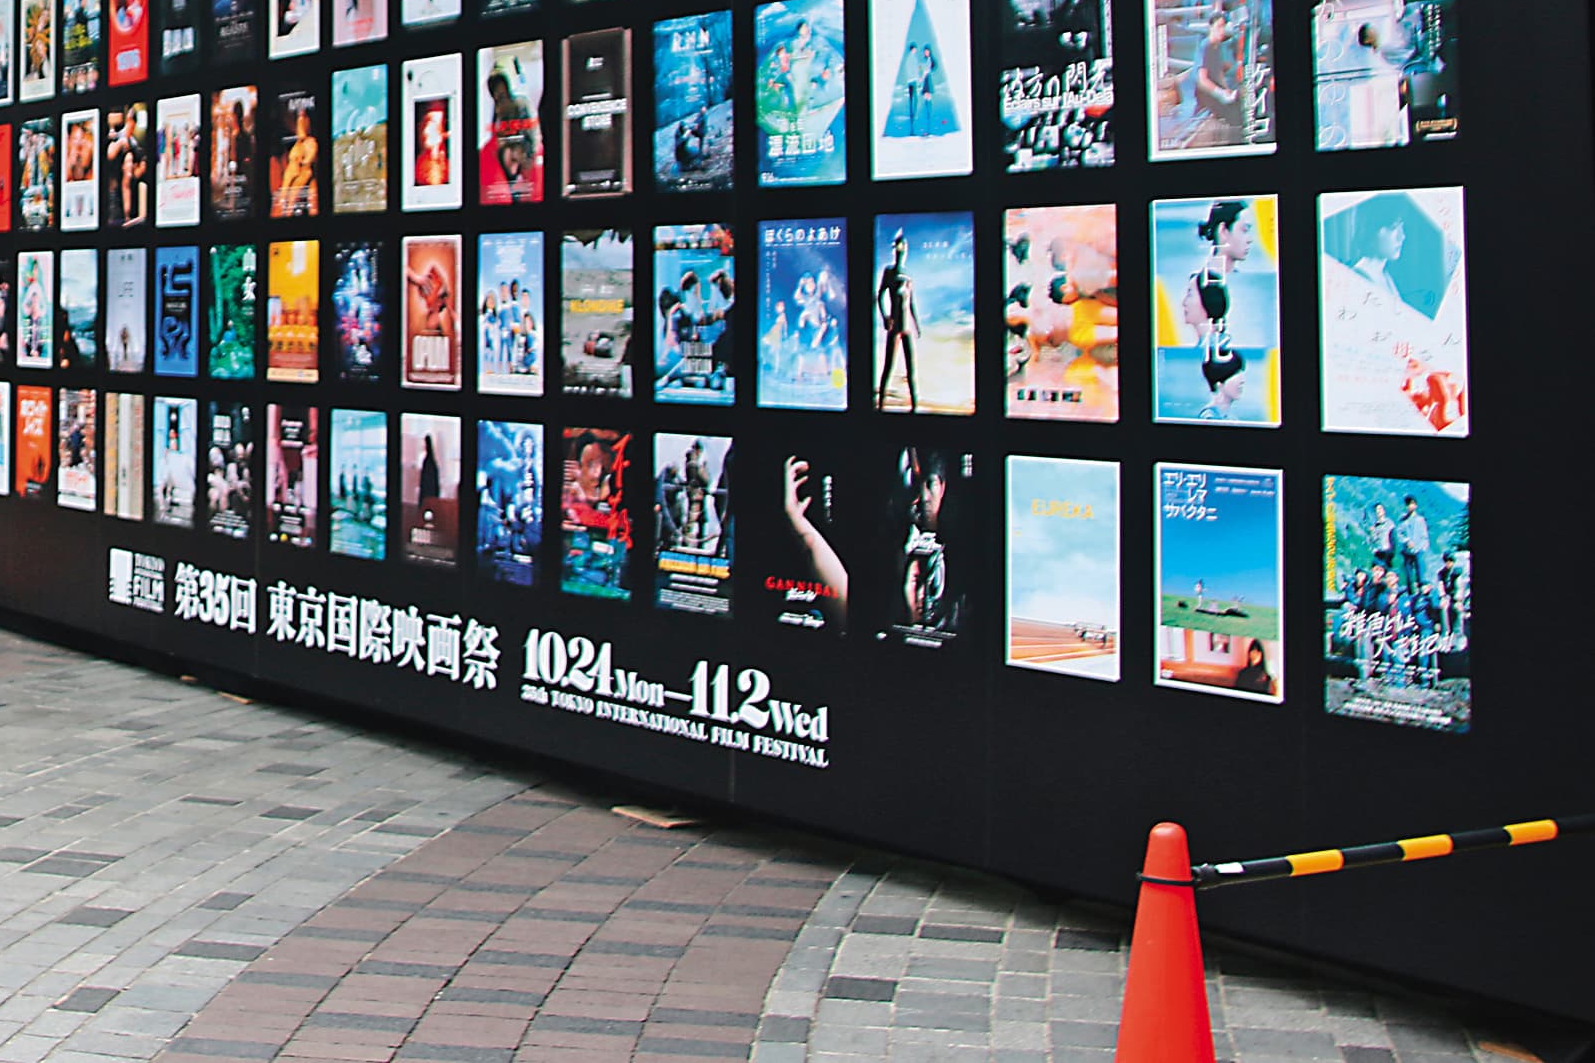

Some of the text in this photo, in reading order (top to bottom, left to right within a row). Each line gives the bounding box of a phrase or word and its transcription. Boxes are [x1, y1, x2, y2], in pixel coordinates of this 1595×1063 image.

[1251, 62, 1272, 135] ケイコ
[1031, 498, 1095, 519] EUREKA
[133, 575, 165, 602] FILM
[174, 561, 502, 689] 第35回 東京国際映画祭
[550, 690, 595, 715] TOKYO
[595, 700, 709, 741] INTERNATIONAL
[710, 726, 750, 752] FILM
[752, 735, 830, 769] FESTIVAL
